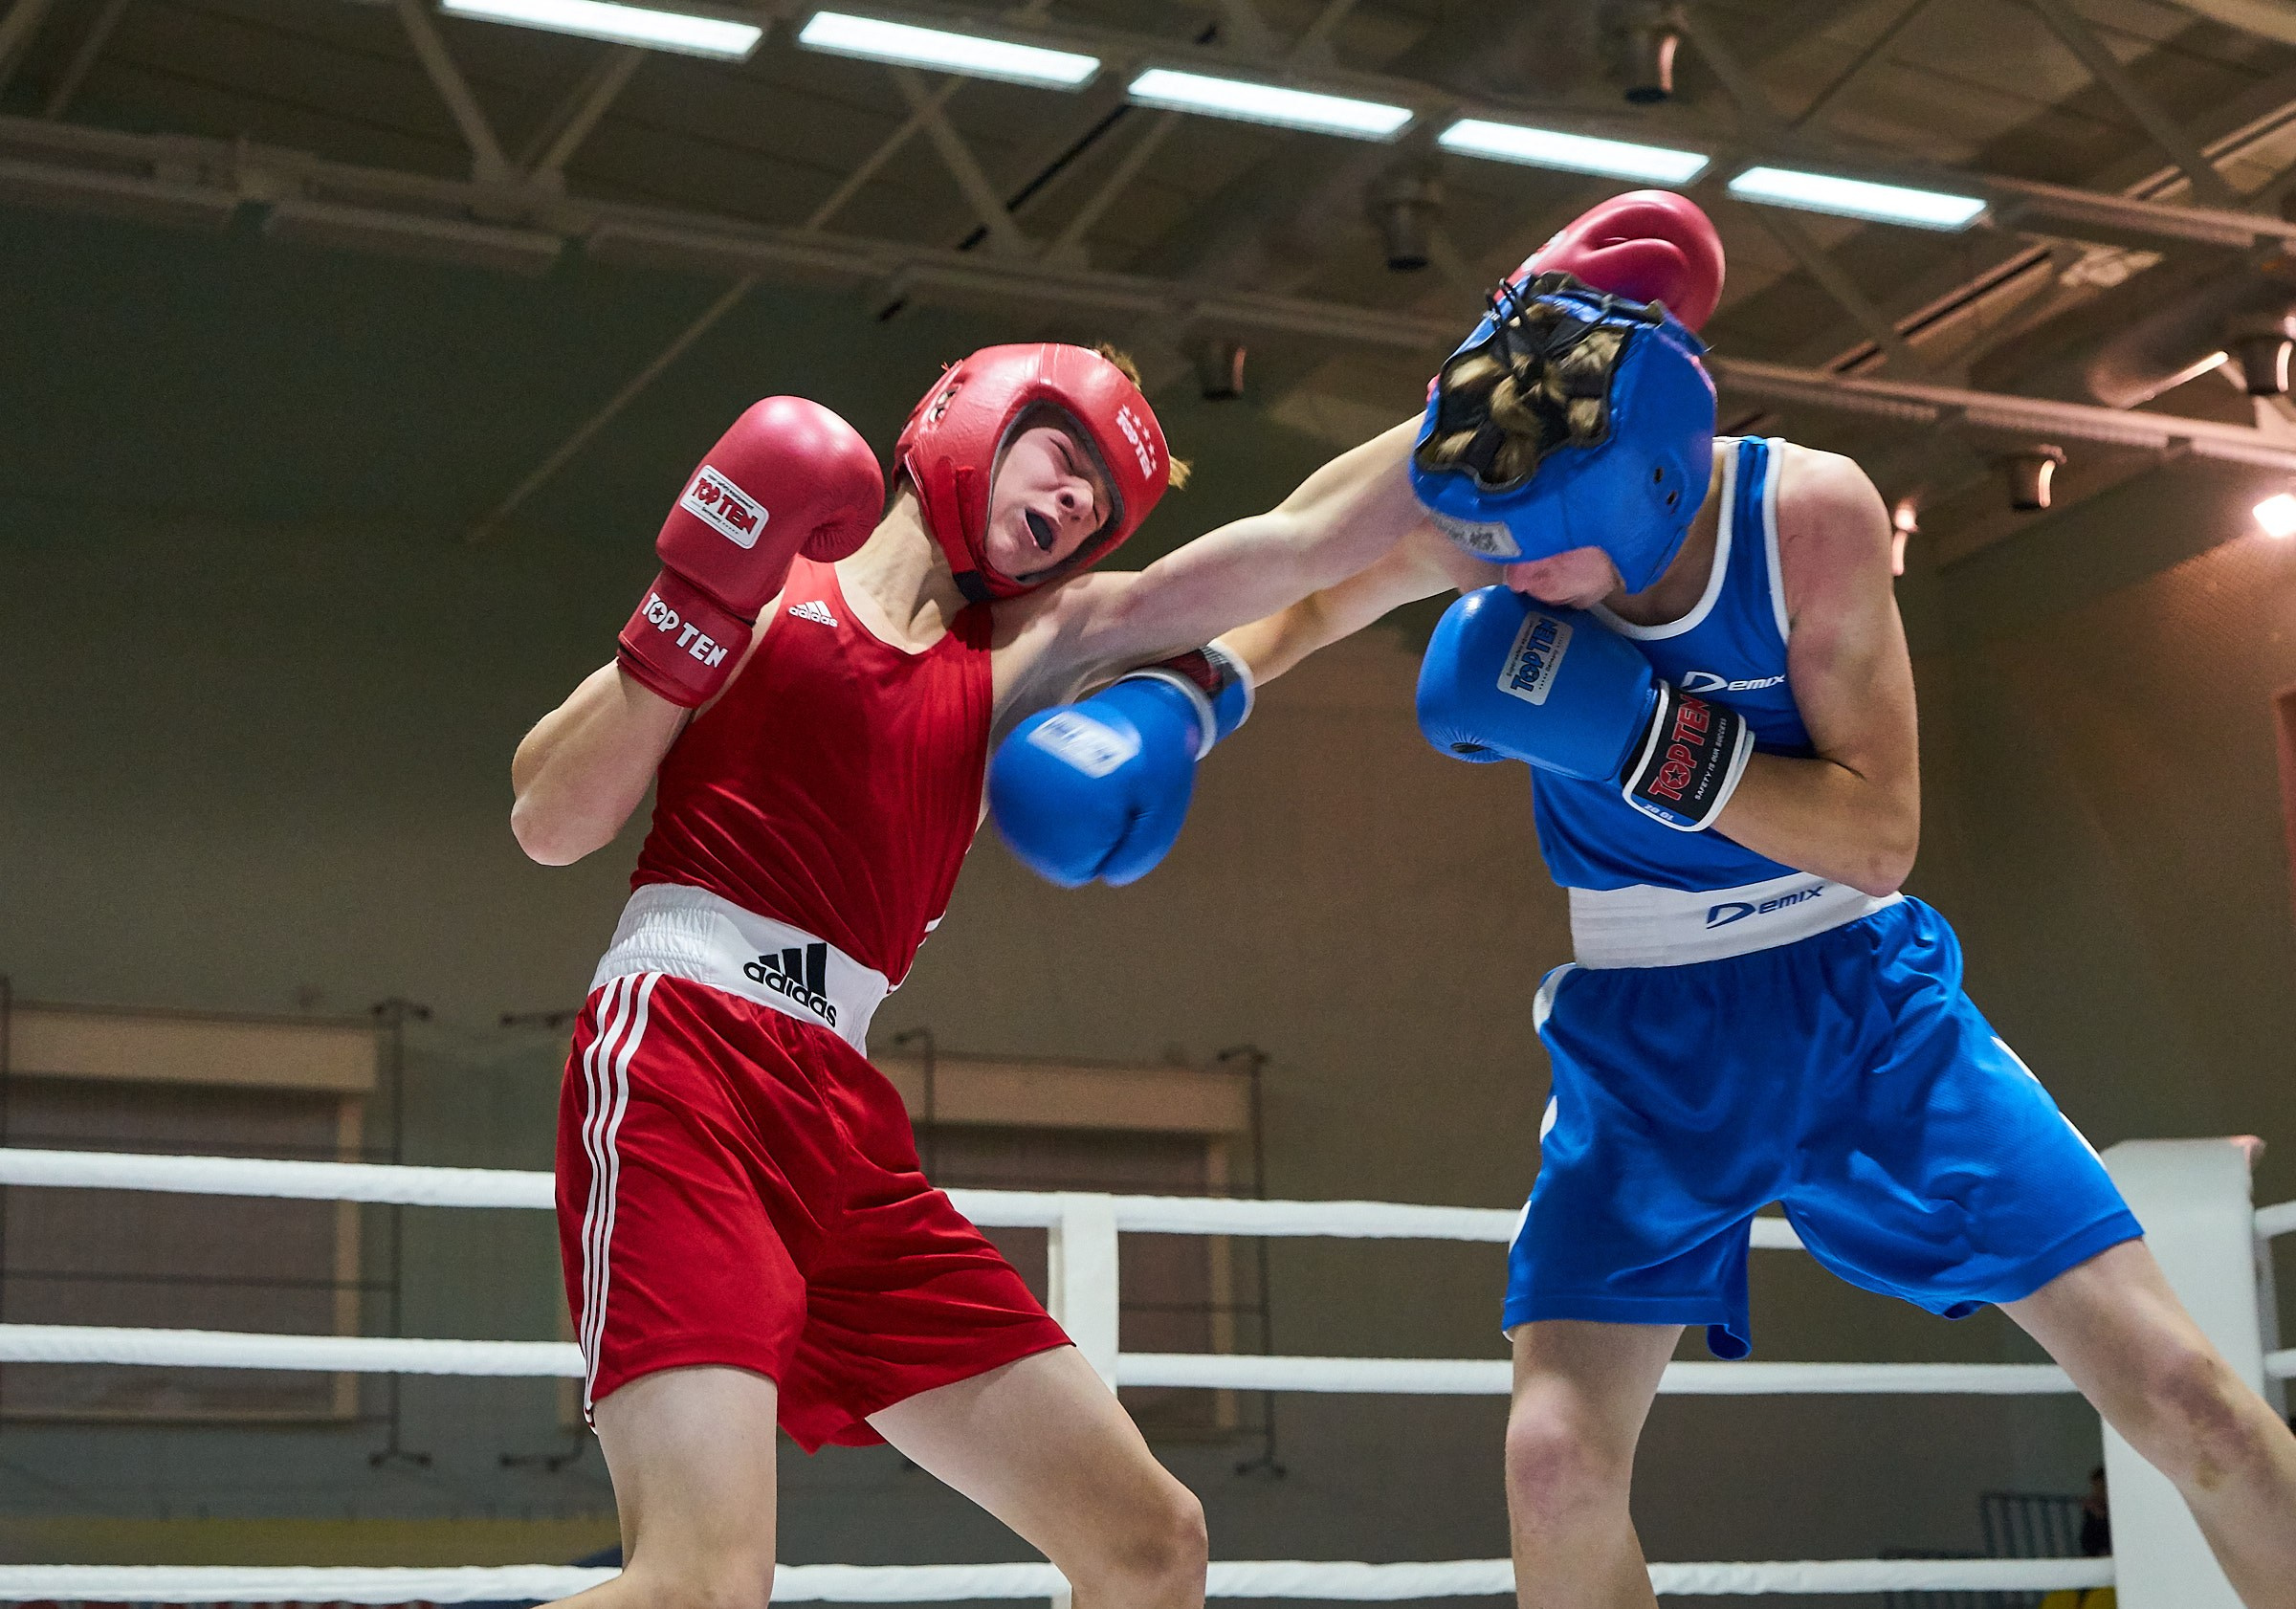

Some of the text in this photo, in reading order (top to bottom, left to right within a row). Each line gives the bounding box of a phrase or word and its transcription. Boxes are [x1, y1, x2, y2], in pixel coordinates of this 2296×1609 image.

[692, 477, 759, 535] TOP TEN
[641, 591, 729, 669] TOP TEN
[788, 606, 839, 628] adidas
[1510, 618, 1558, 693] TOP TEN
[1680, 671, 1786, 694] Demix
[1647, 694, 1711, 801] TOP TEN
[1694, 772, 1713, 801] SAFETY
[1706, 885, 1824, 930] Demix
[743, 961, 837, 1028] adidas
